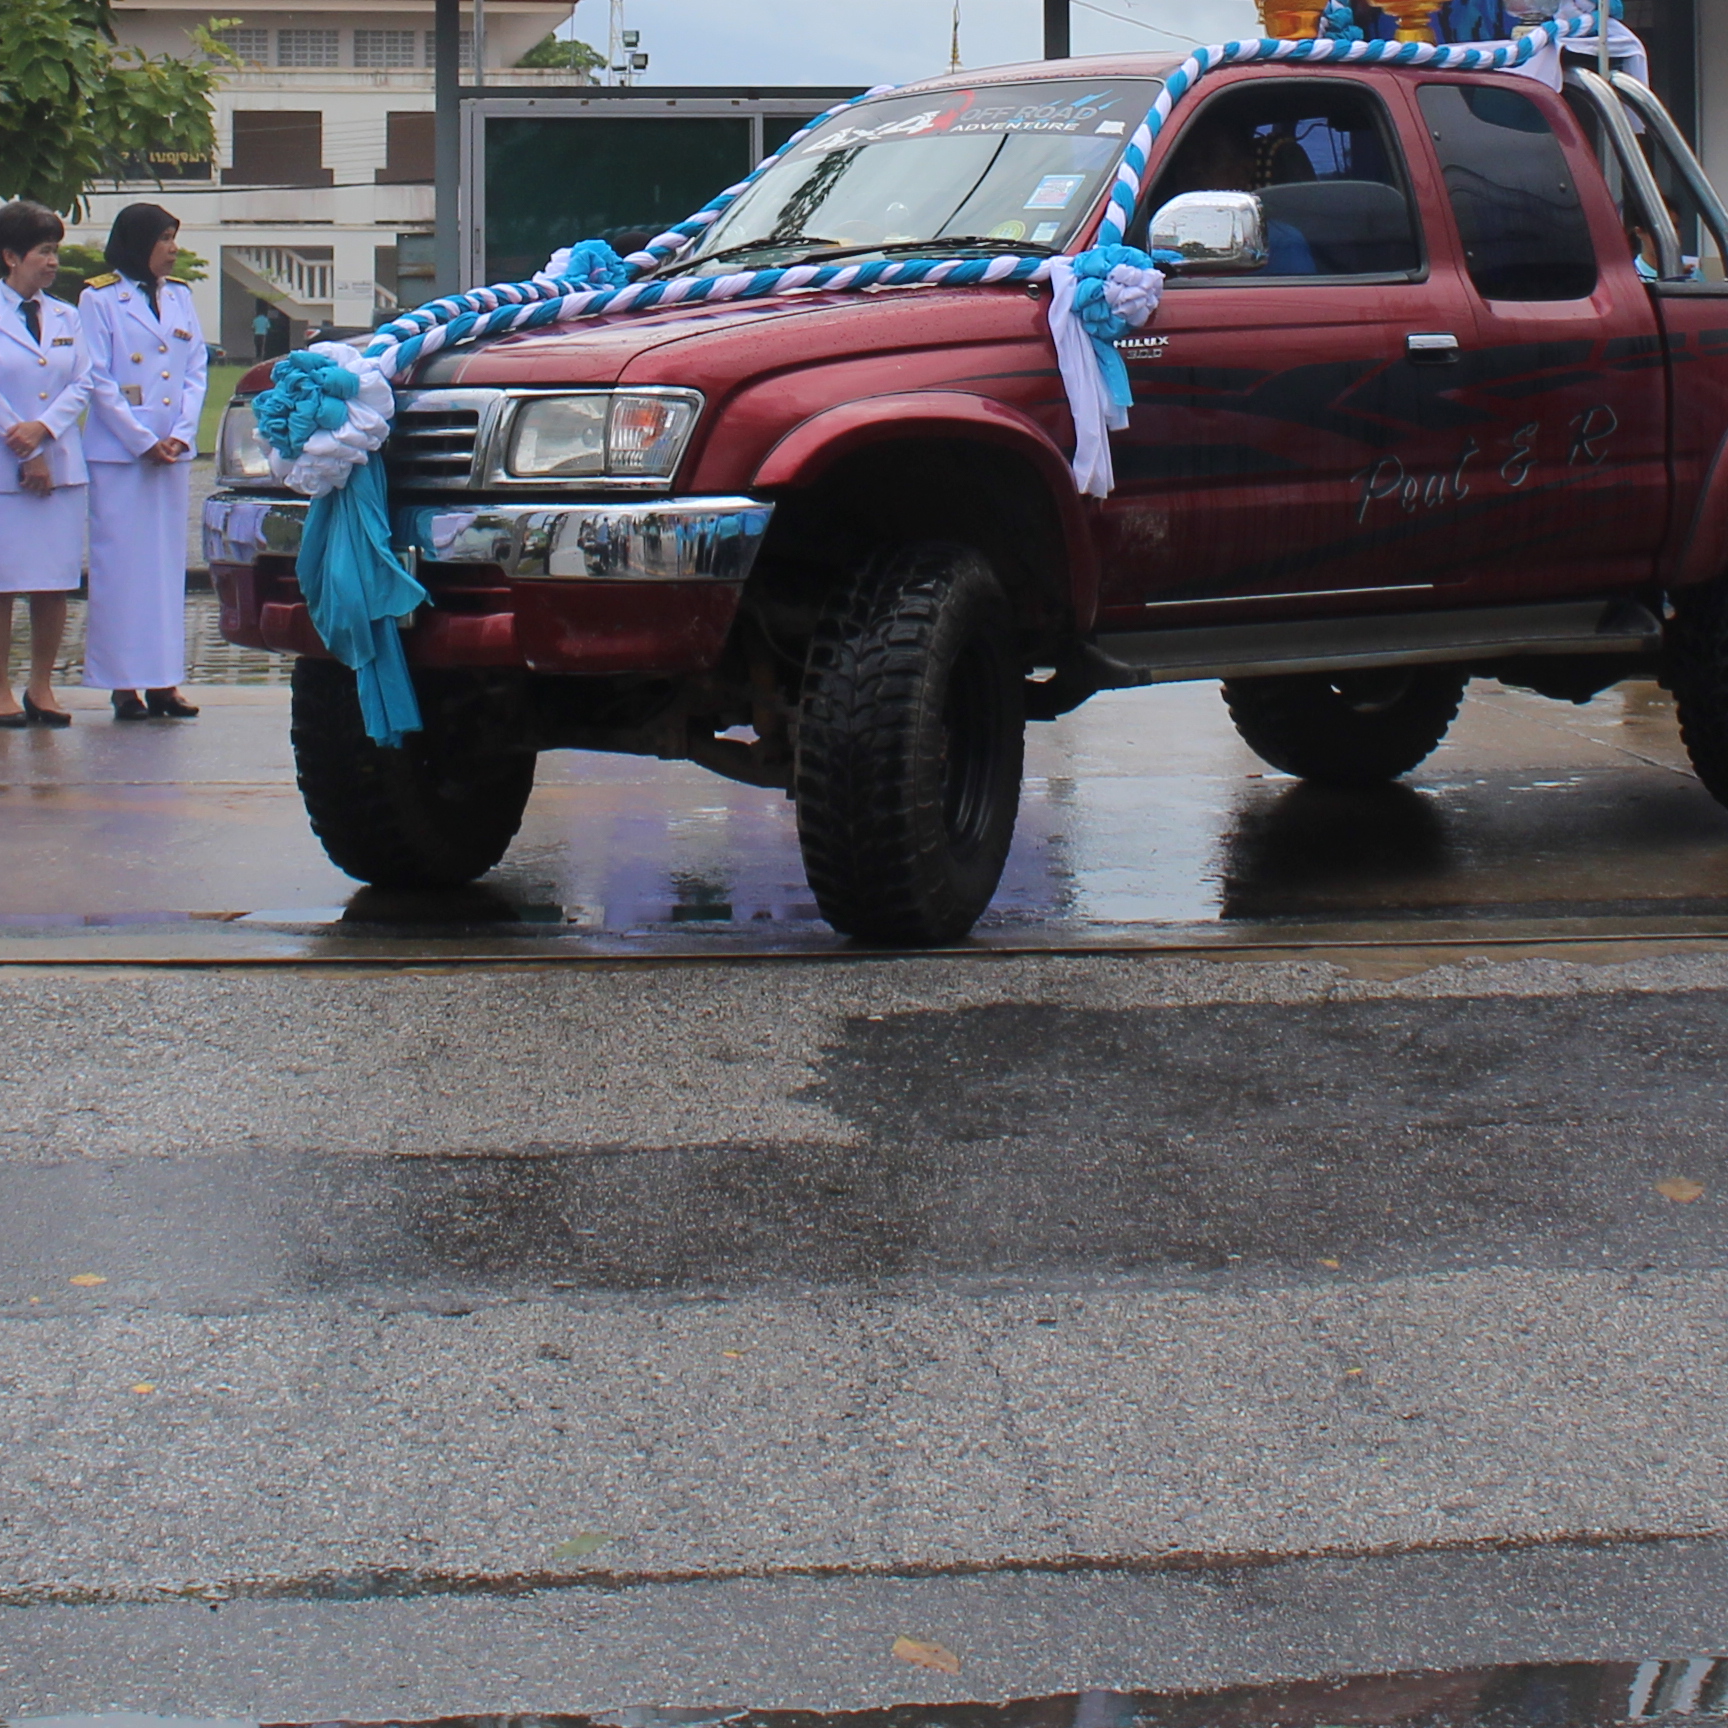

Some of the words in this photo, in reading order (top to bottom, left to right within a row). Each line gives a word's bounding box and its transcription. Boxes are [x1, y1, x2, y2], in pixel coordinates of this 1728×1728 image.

[960, 106, 1015, 121] OFF
[1015, 105, 1098, 121] ROAD
[949, 122, 1080, 133] ADVENTURE
[1112, 335, 1170, 349] HILUX
